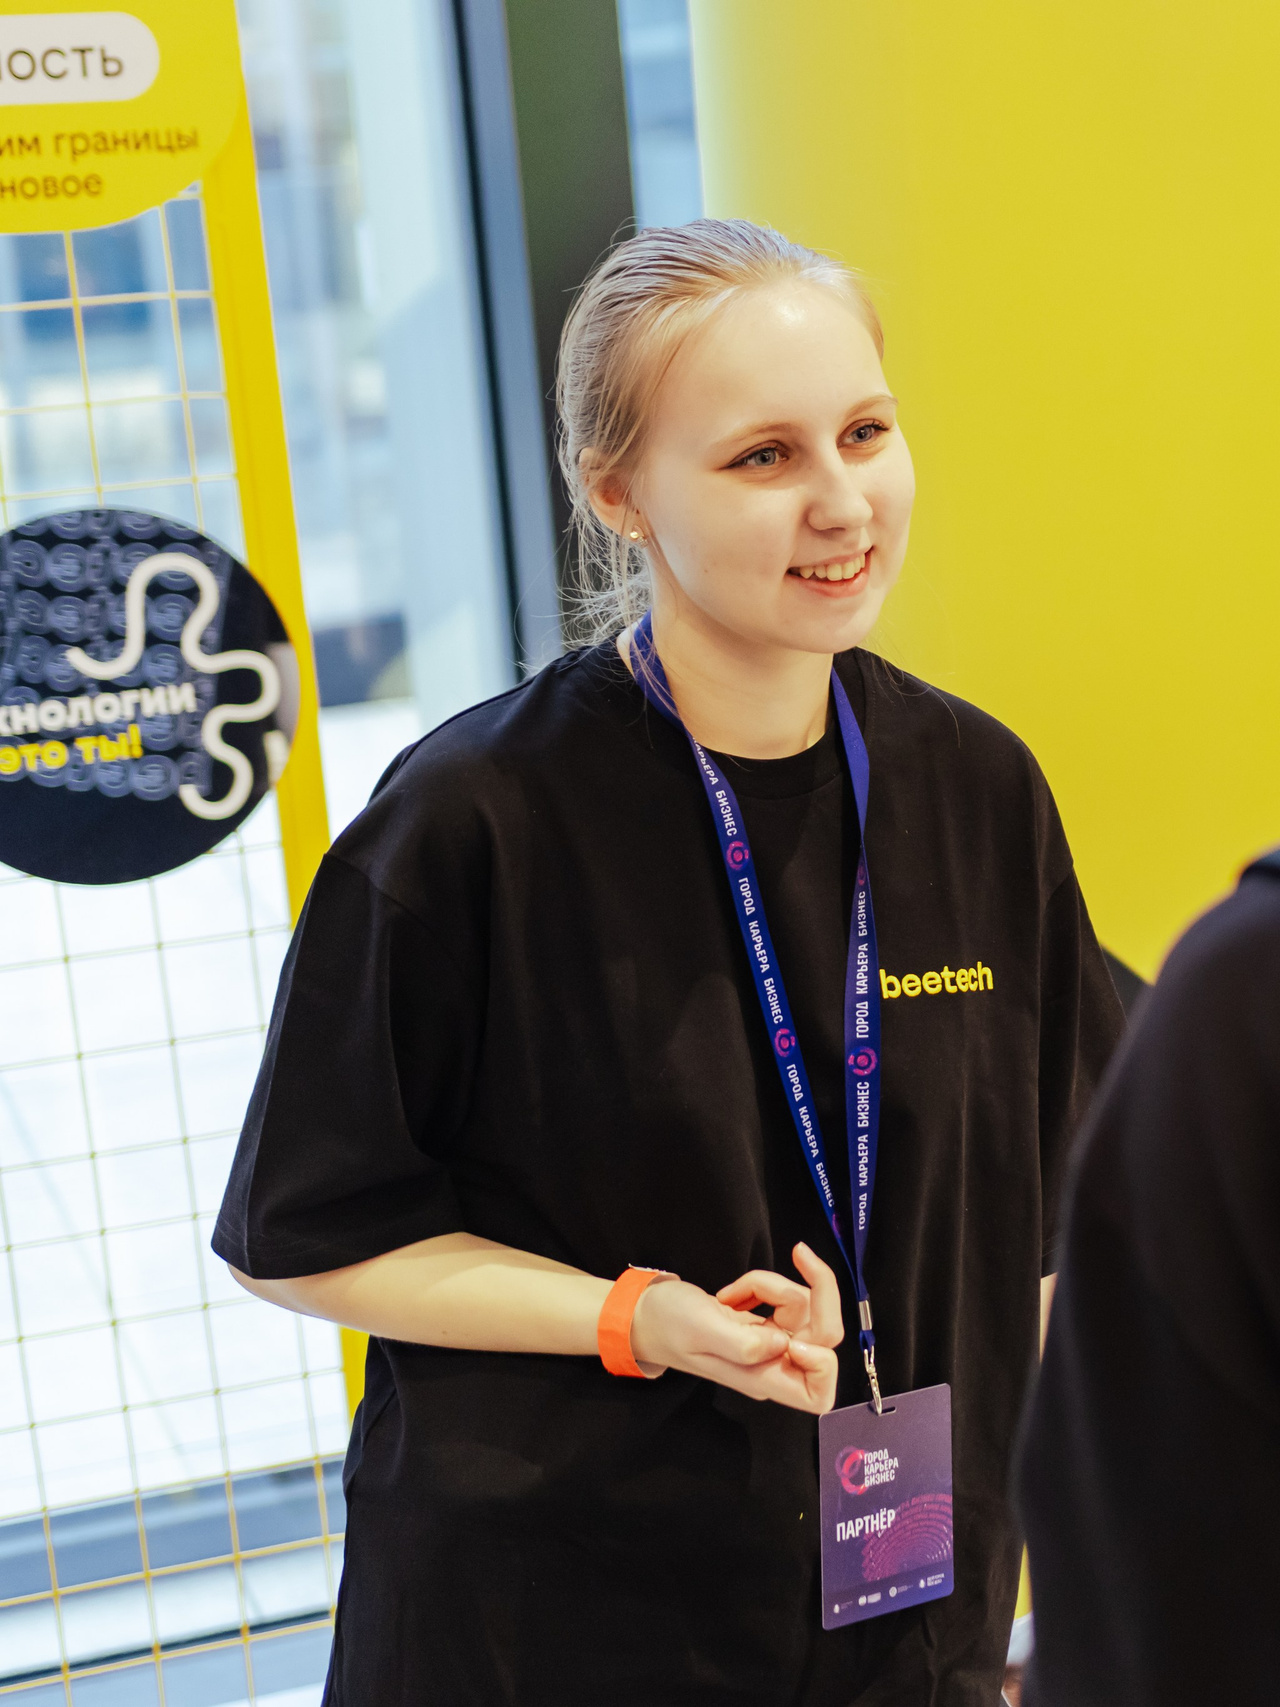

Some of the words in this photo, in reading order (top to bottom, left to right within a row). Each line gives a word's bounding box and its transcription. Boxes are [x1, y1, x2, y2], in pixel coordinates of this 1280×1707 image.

[0, 46, 124, 80] ость
[54, 127, 200, 163] границы
[0, 173, 103, 200] новое
[0, 740, 69, 775] это
[74, 724, 144, 764] ты!
[857, 891, 867, 937] БИЗНЕС
[693, 737, 719, 785] АРЬЕРА
[715, 790, 738, 837] БИЗНЕС
[738, 877, 756, 915] ГОРОД
[748, 920, 770, 973] КАРЬЕРА
[763, 978, 784, 1024] БИЗНЕС
[786, 1064, 804, 1102] ГОРОД
[798, 1106, 820, 1158] КАРЬЕРА
[815, 1162, 835, 1208] БИЗНЕС
[856, 943, 869, 994] КАРЬЕРА
[879, 962, 994, 999] beetech
[856, 1001, 869, 1038] ГОРОД
[857, 1081, 870, 1128] БИЗНЕС
[858, 1134, 869, 1186] КАРЬЕРА
[858, 1193, 868, 1230] ГОРОД
[863, 1448, 889, 1465] ГОРОД
[864, 1457, 899, 1476] КАРЬЕРА
[864, 1469, 896, 1487] БИЗНЕС
[836, 1508, 896, 1542] ПАРТНЁР
